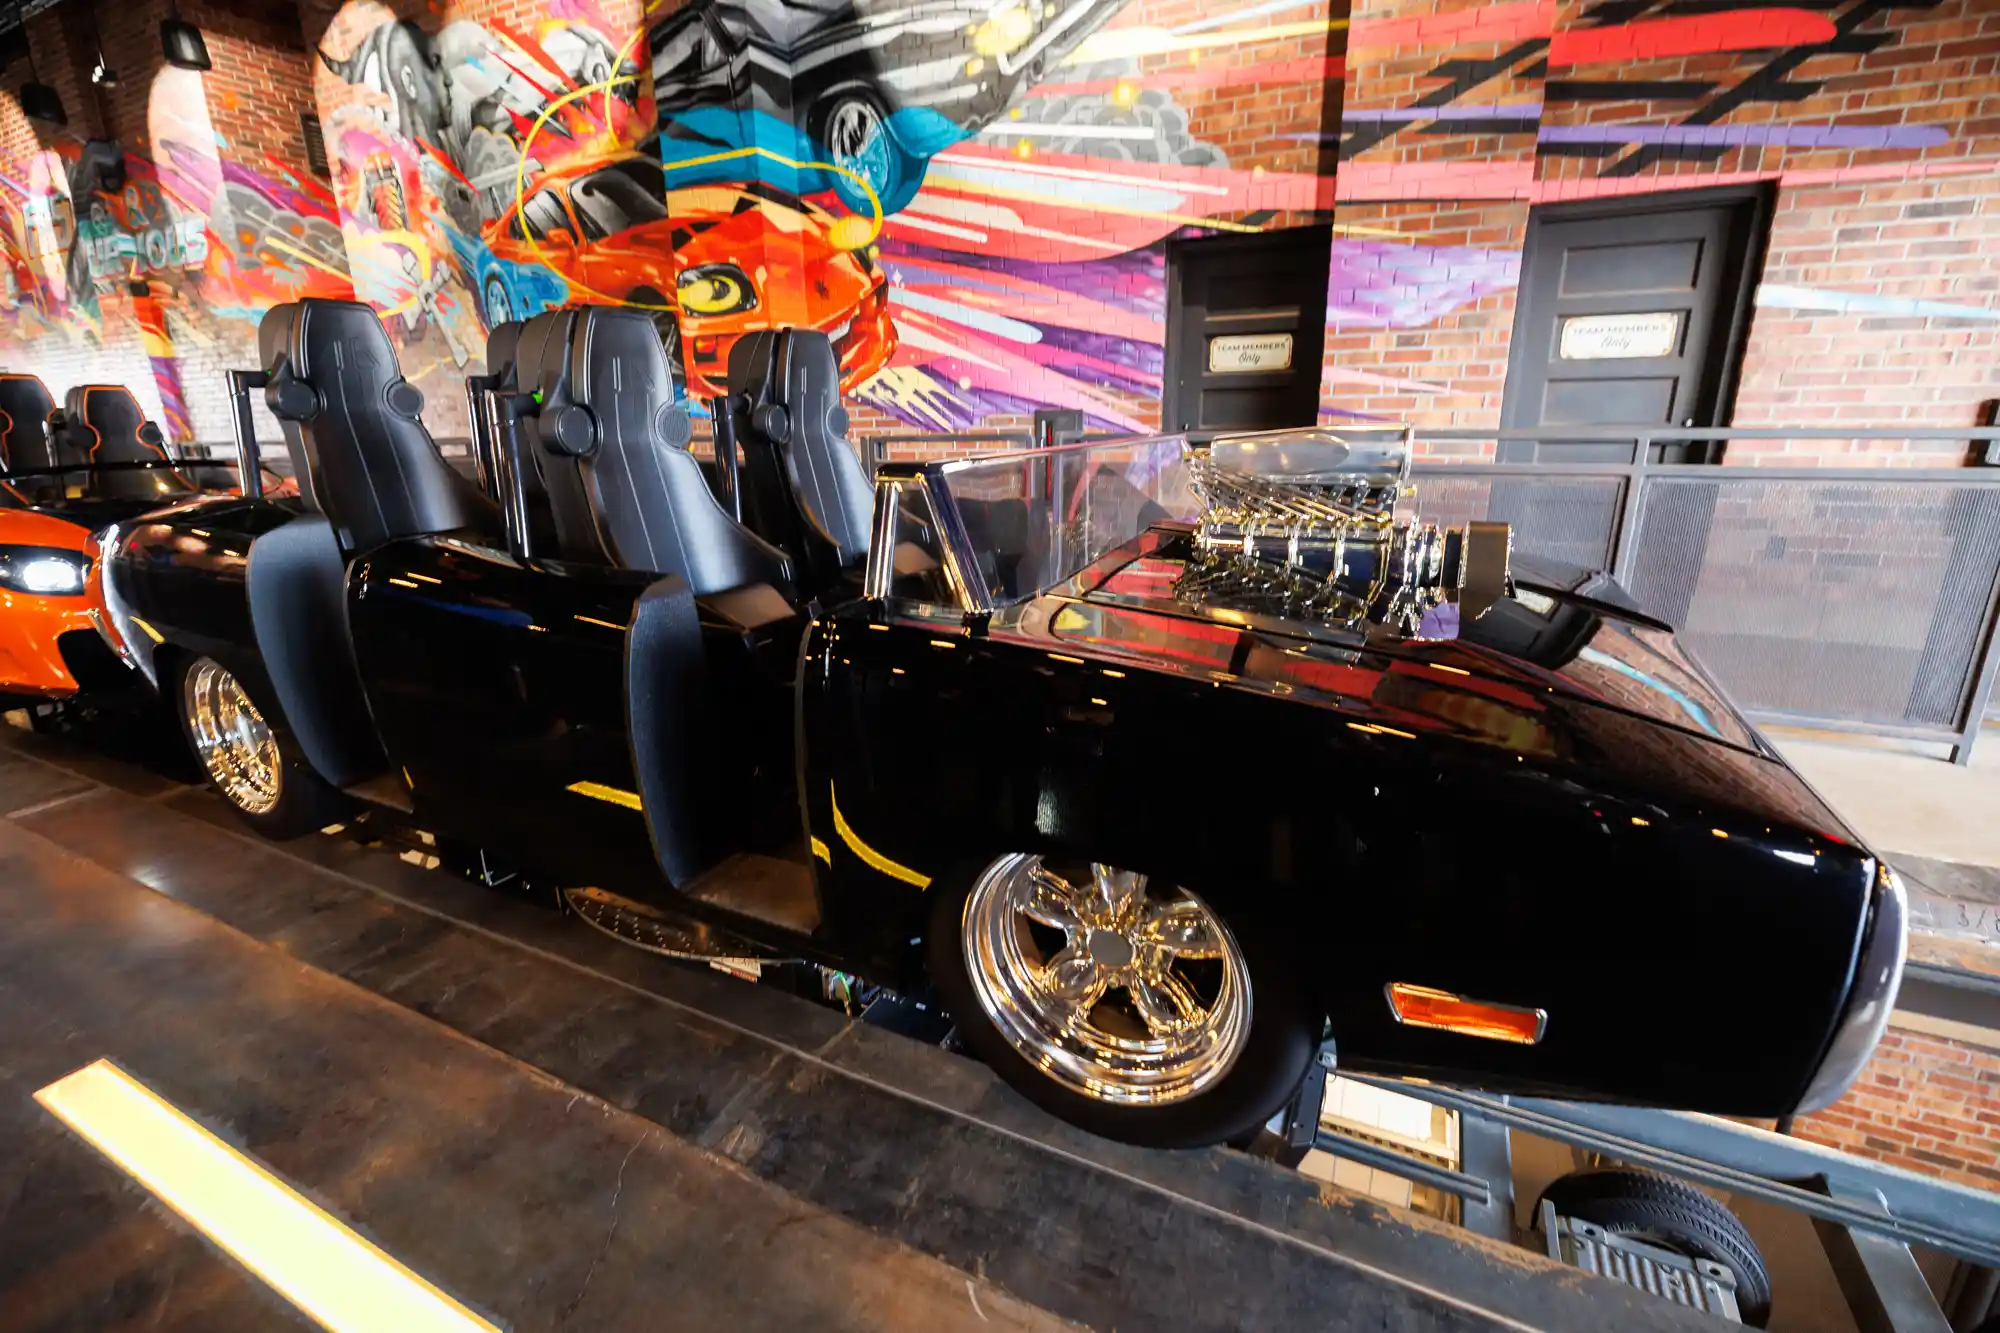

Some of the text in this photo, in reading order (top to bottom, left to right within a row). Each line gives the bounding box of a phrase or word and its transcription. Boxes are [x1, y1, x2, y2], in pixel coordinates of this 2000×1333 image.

[1573, 323, 1668, 335] TEAM MEMBERS
[1217, 341, 1286, 352] TEAM MEMBERS
[1600, 336, 1632, 350] Only
[1238, 351, 1261, 366] Only
